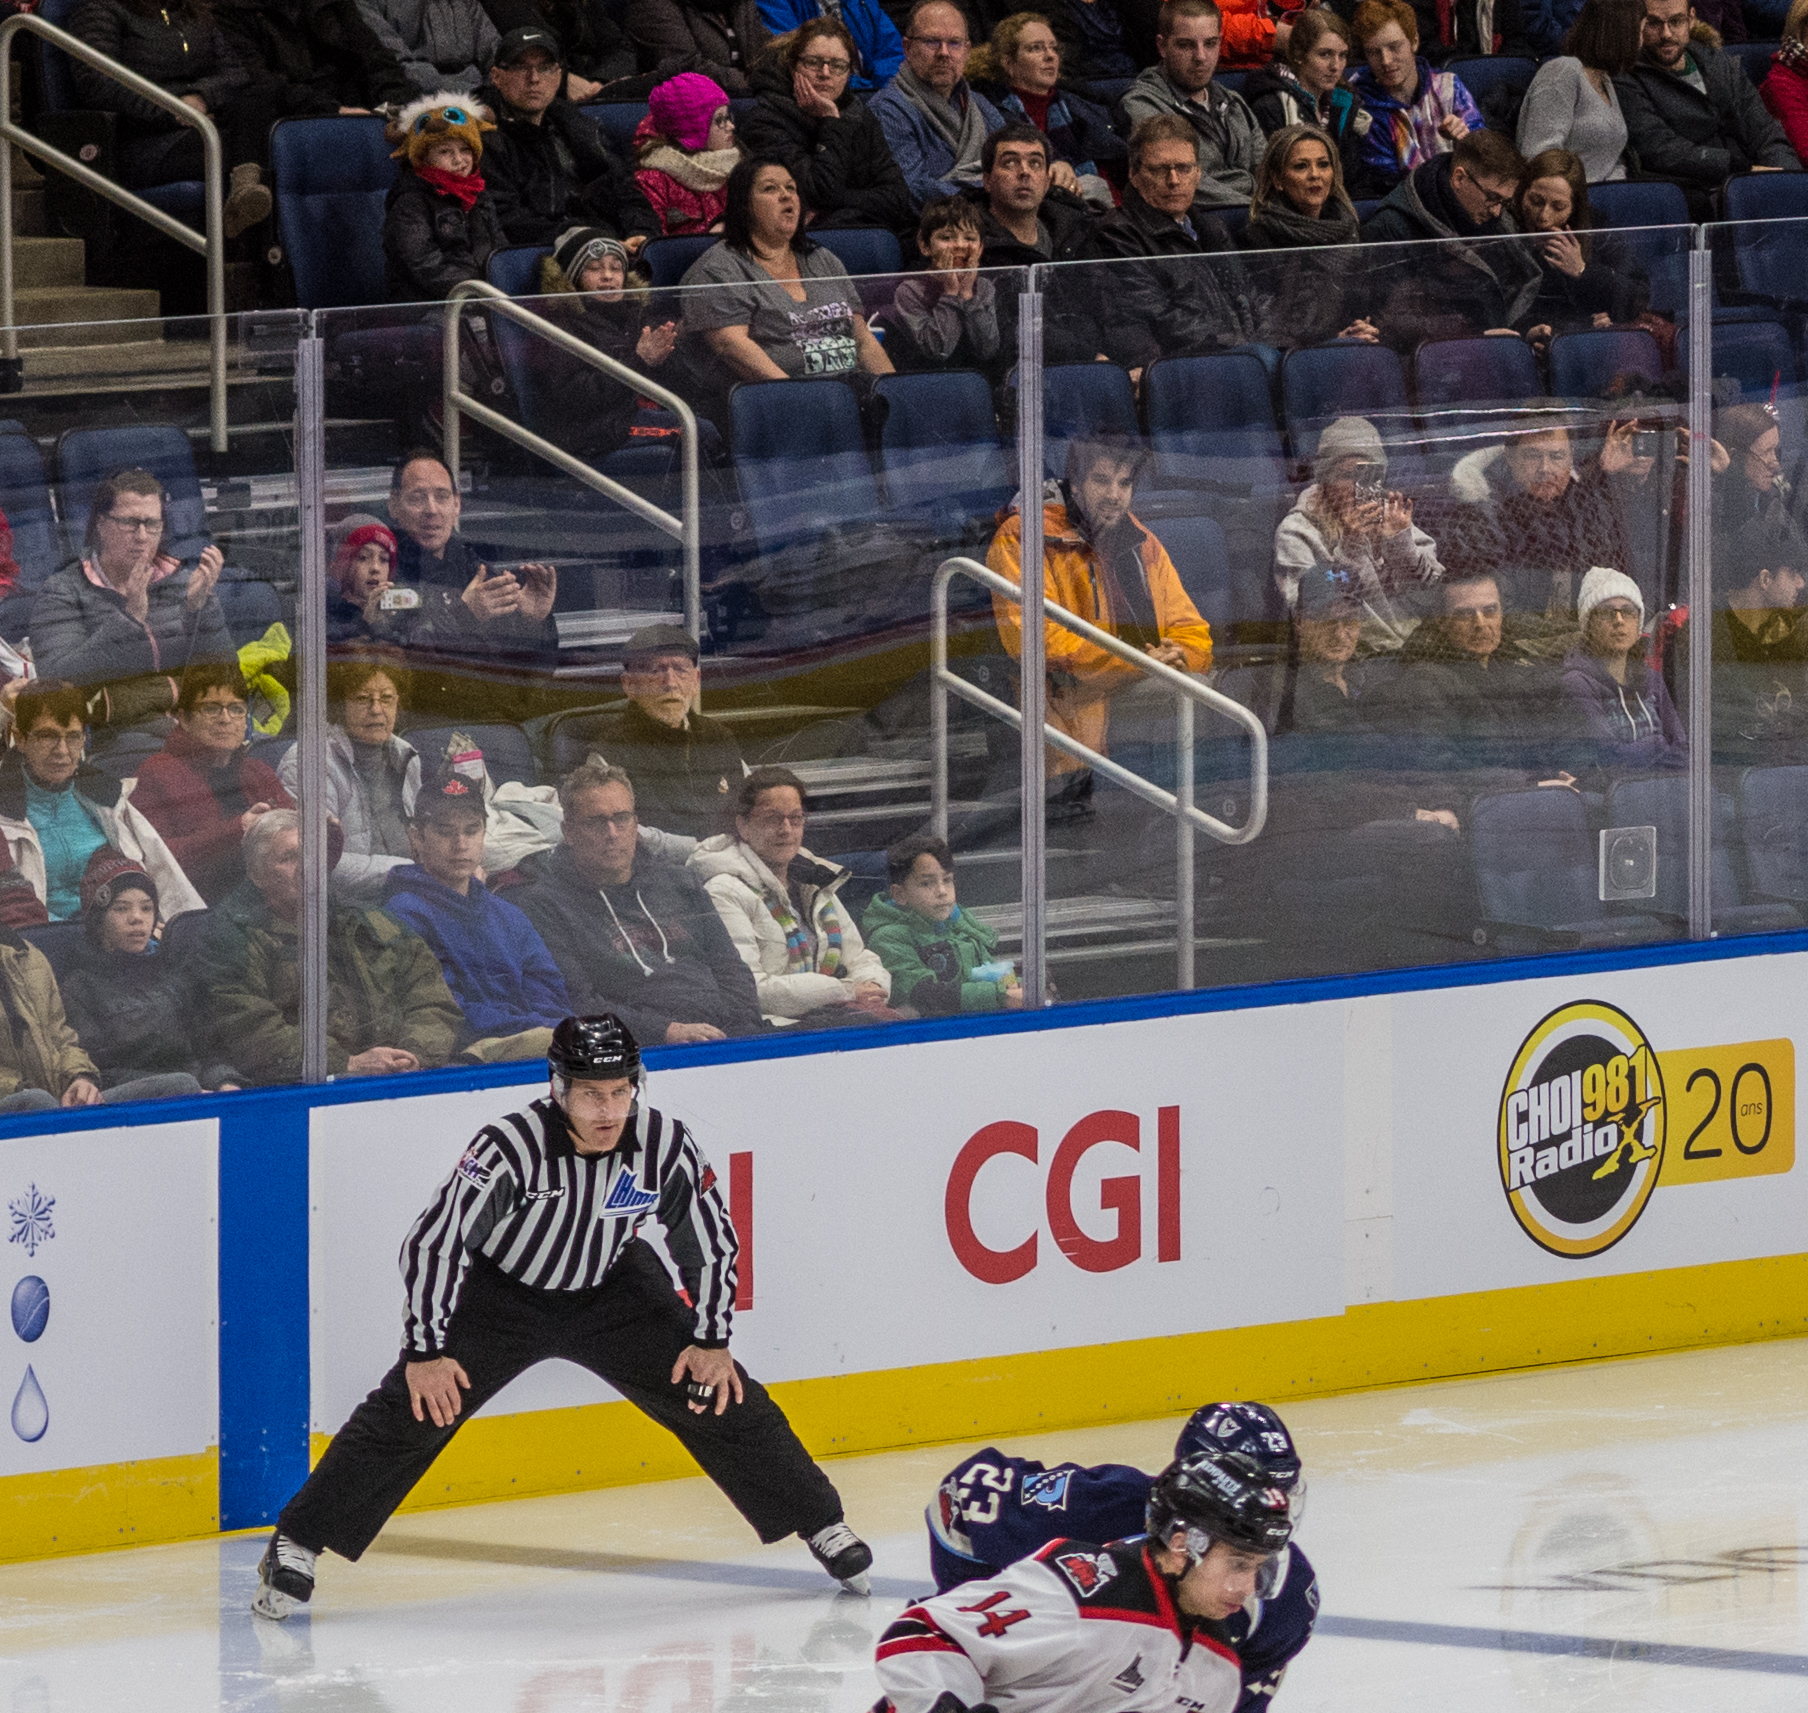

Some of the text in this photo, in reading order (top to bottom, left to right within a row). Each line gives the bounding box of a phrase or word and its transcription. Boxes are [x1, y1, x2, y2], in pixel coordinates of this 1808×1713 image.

[593, 1054, 623, 1065] CCM
[1506, 1072, 1583, 1150] CHOI
[1684, 1061, 1774, 1161] 20
[1739, 1099, 1764, 1119] ans
[944, 1105, 1182, 1285] CGI
